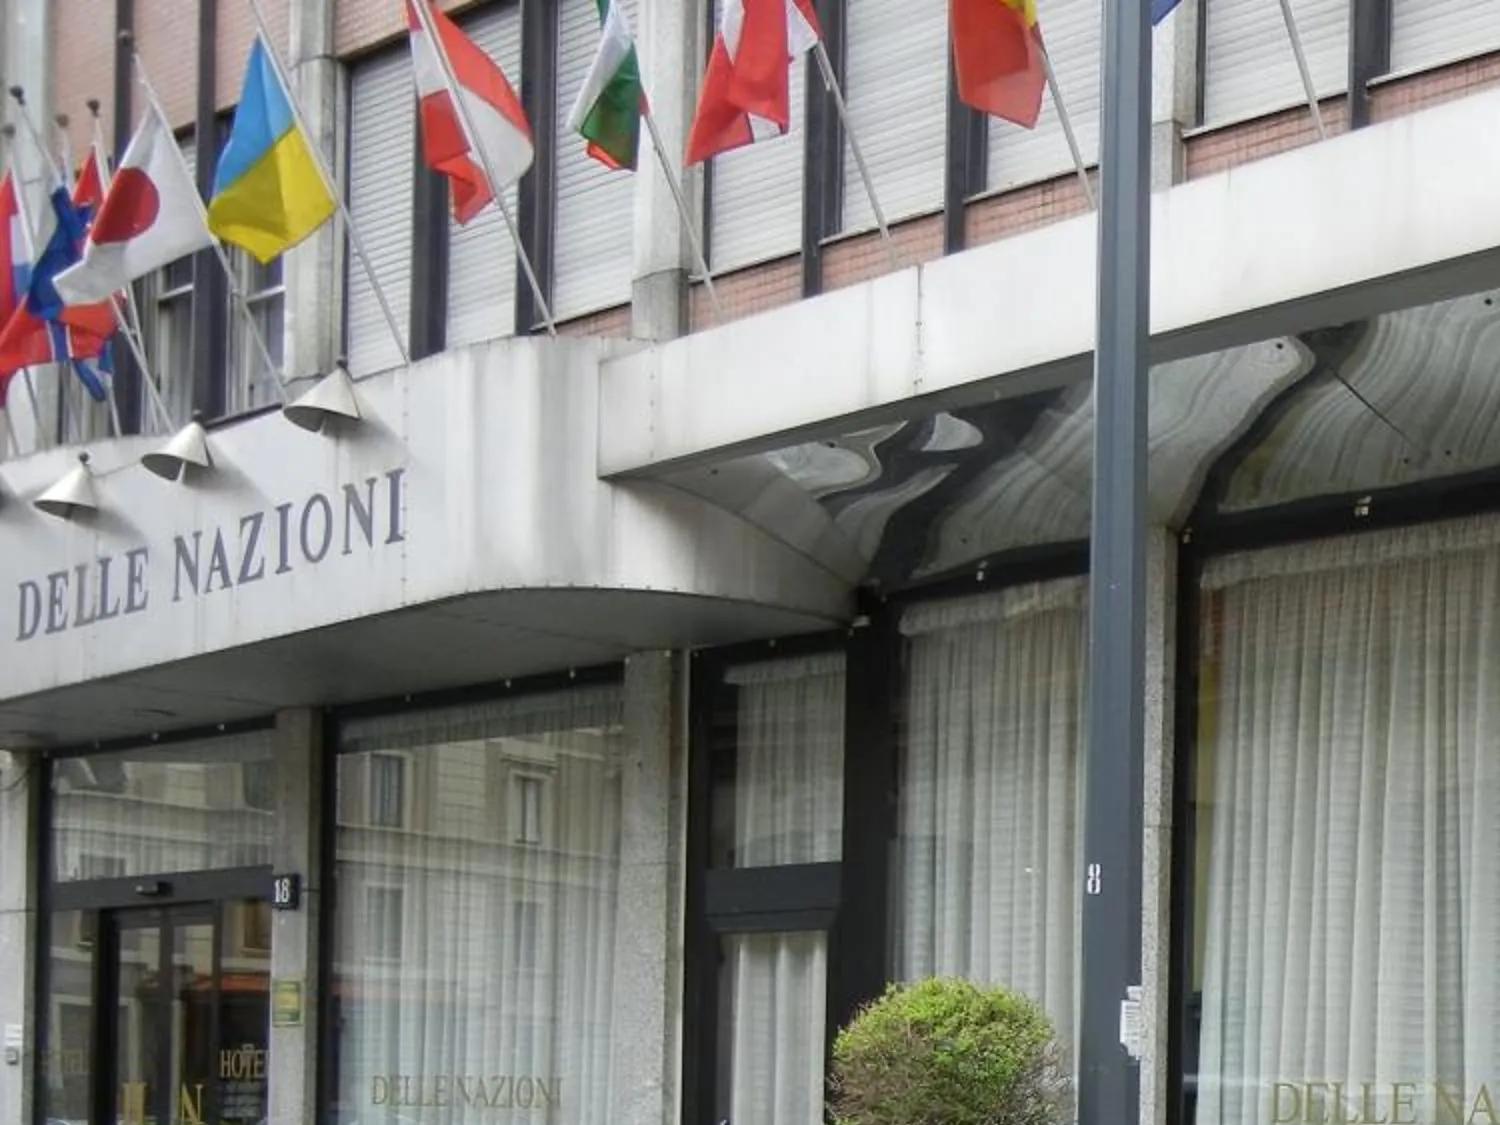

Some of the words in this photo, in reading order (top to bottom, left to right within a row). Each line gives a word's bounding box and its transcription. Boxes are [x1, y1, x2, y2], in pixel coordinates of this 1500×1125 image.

[16, 546, 149, 641] DELLE
[172, 468, 405, 602] NAZIONI
[275, 877, 290, 903] 18
[372, 1075, 449, 1107] DELLE
[456, 1076, 564, 1109] NAZIONI
[1271, 1081, 1416, 1125] DELLE
